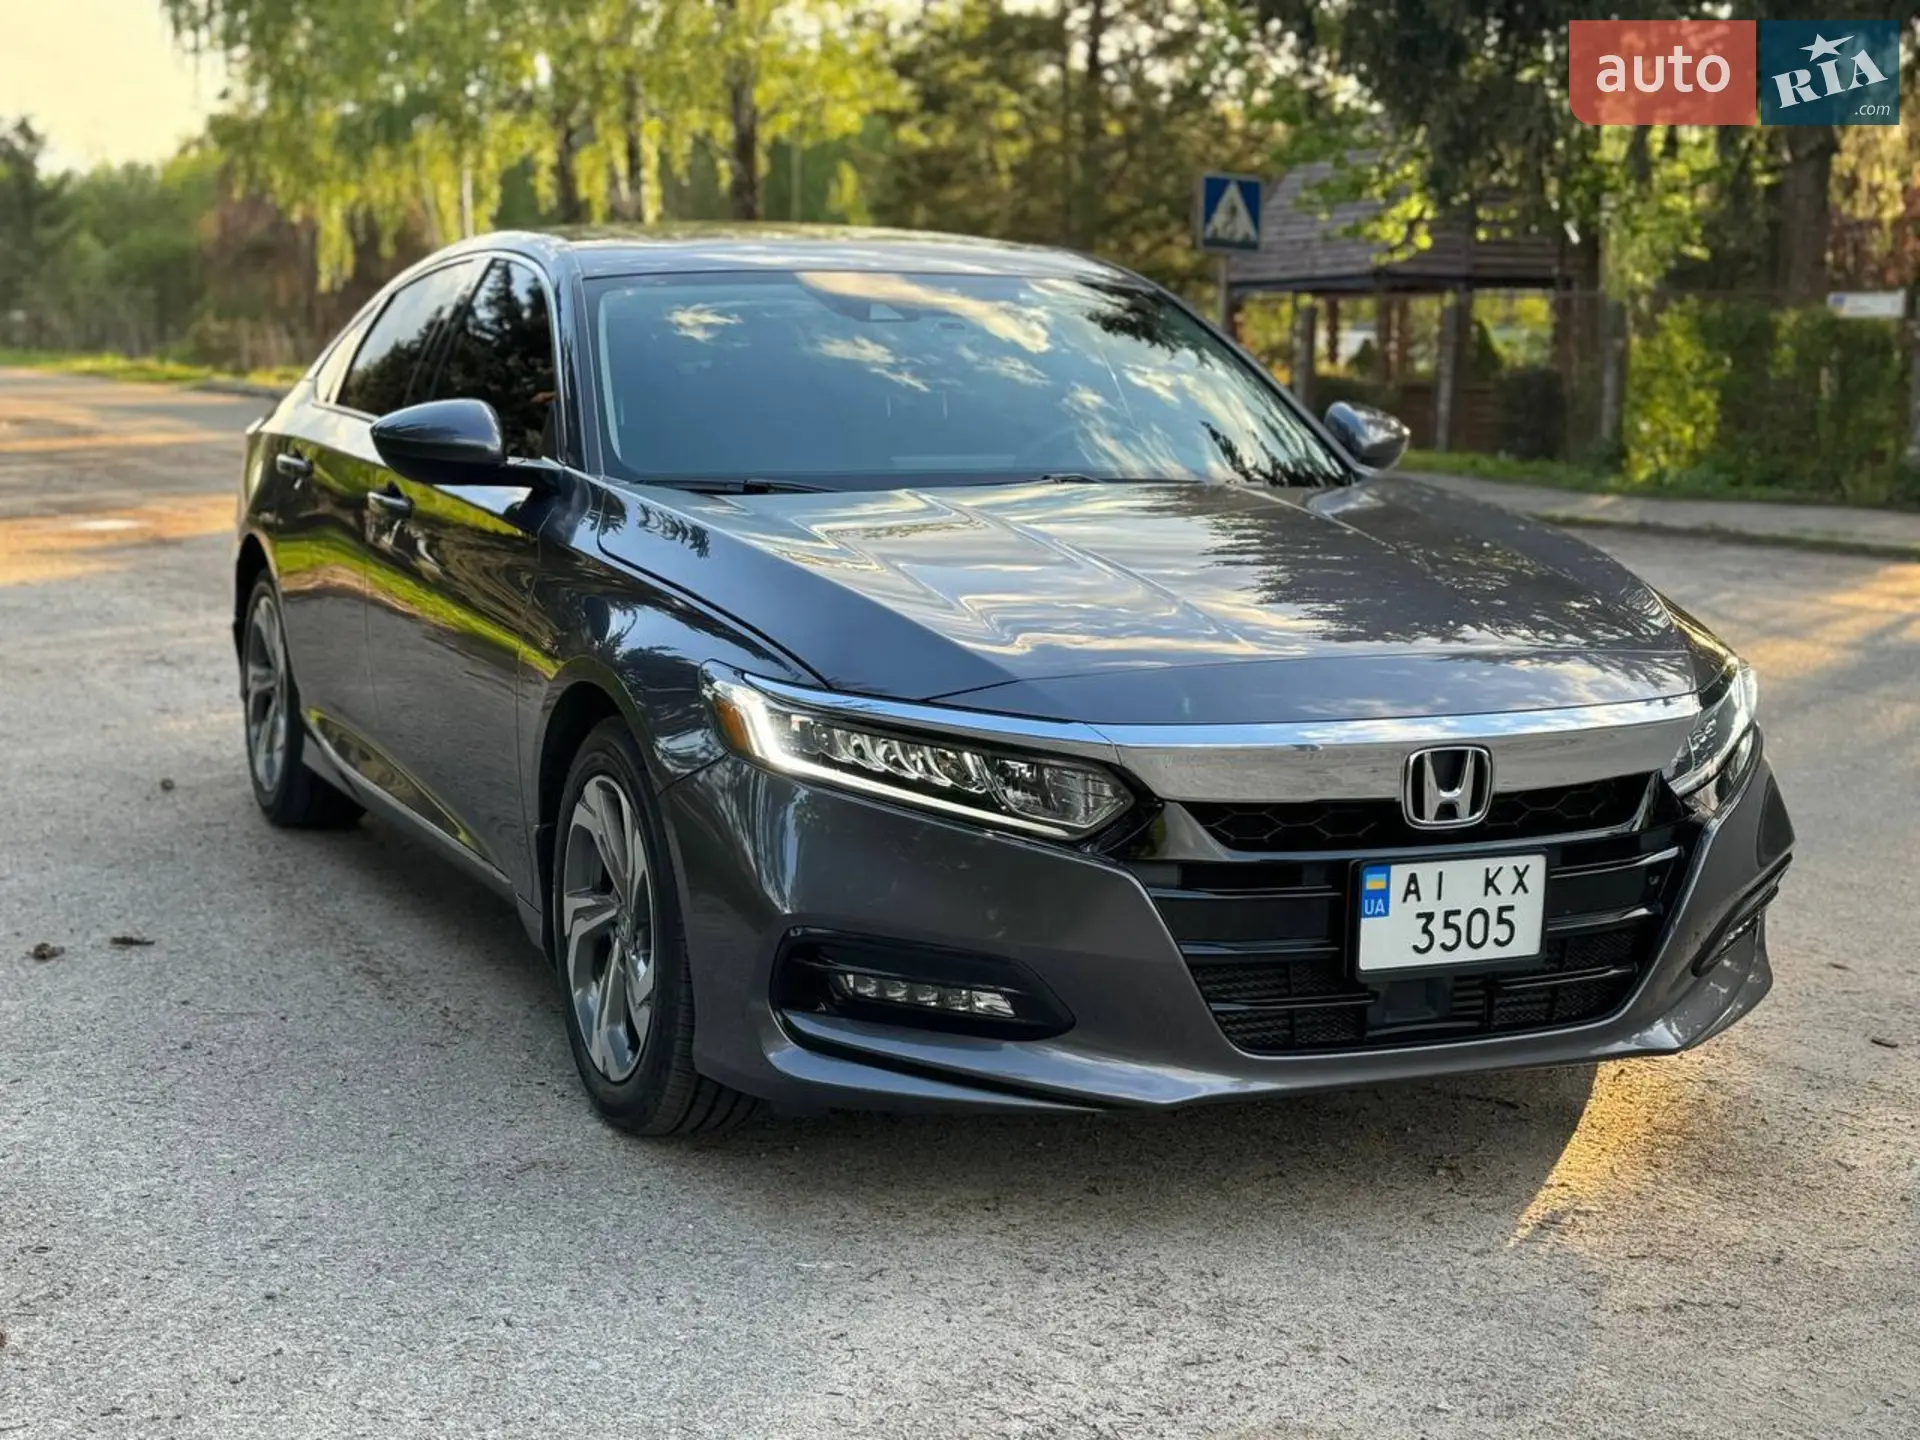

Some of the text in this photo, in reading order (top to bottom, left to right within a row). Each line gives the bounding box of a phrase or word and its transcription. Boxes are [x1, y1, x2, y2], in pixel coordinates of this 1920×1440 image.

[1402, 864, 1531, 903] AI KX
[1364, 898, 1386, 915] UA
[1412, 905, 1516, 955] 3505
